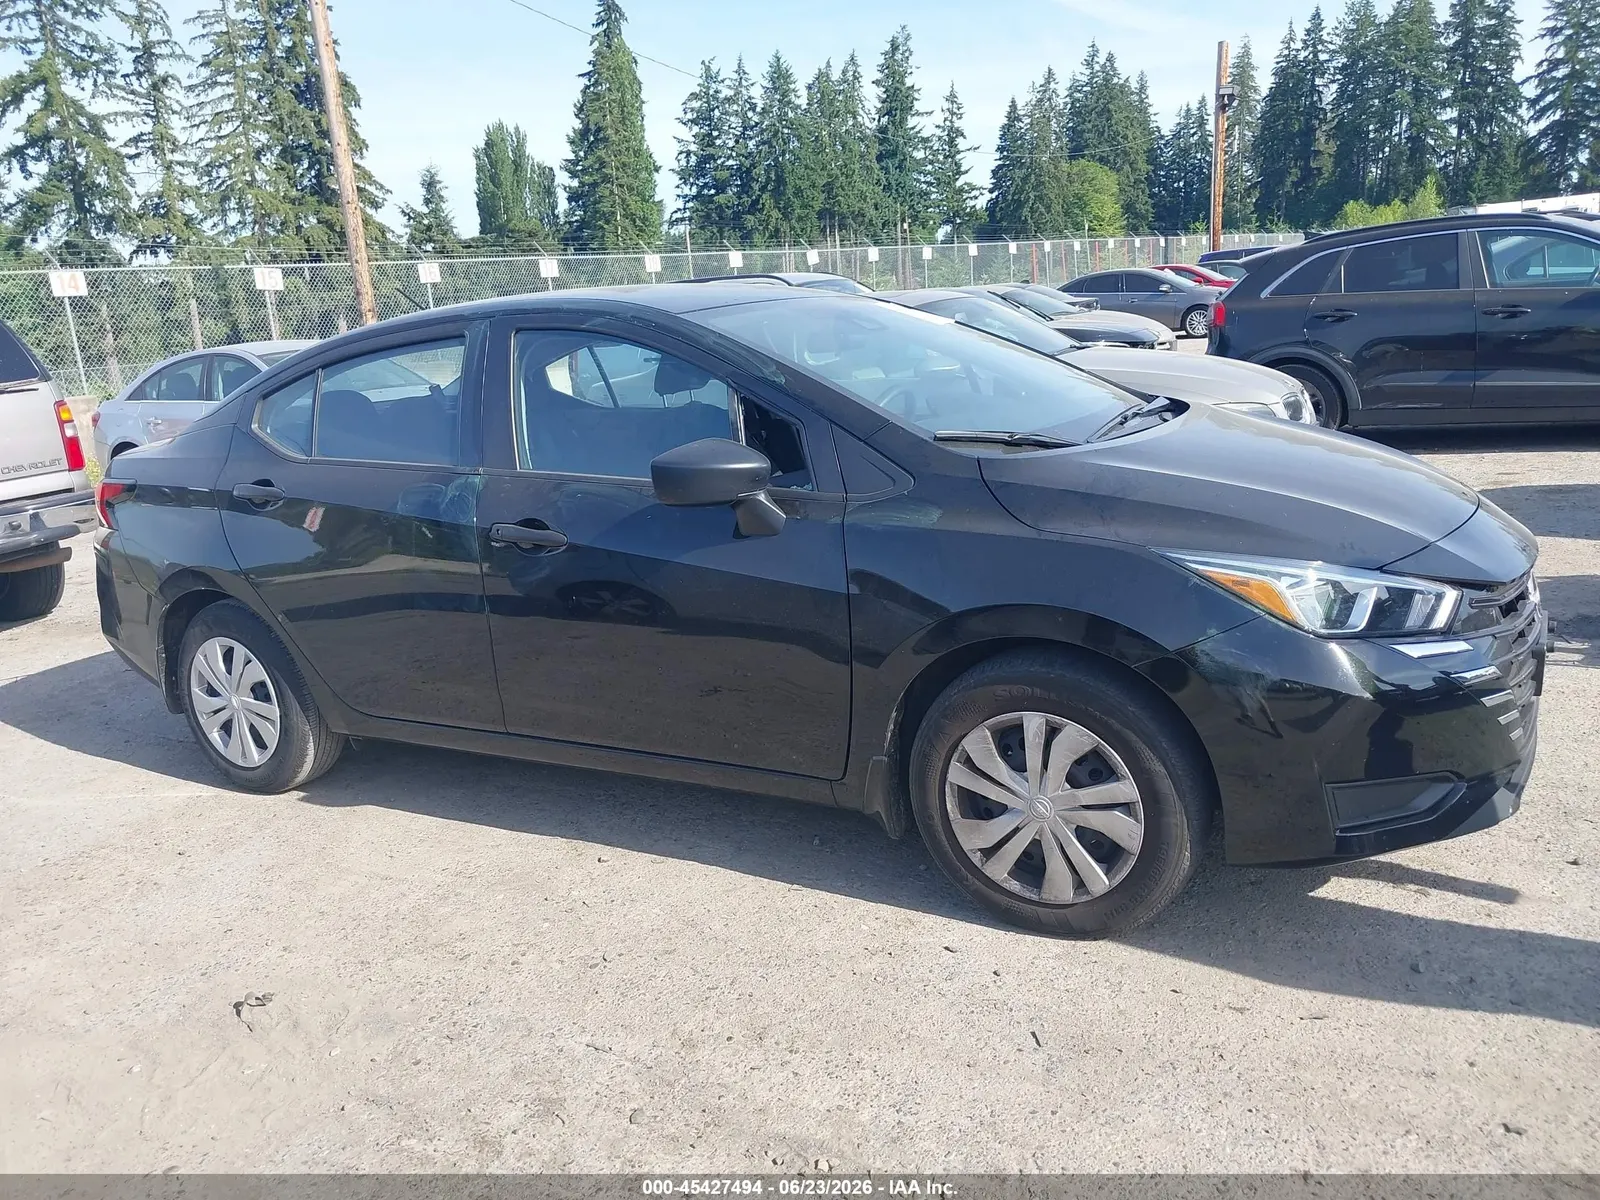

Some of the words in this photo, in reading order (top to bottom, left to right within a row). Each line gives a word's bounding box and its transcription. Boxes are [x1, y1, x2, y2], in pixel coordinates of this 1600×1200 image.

[57, 273, 80, 293] 14
[259, 270, 278, 288] 15
[1, 458, 62, 474] CHEVROLET
